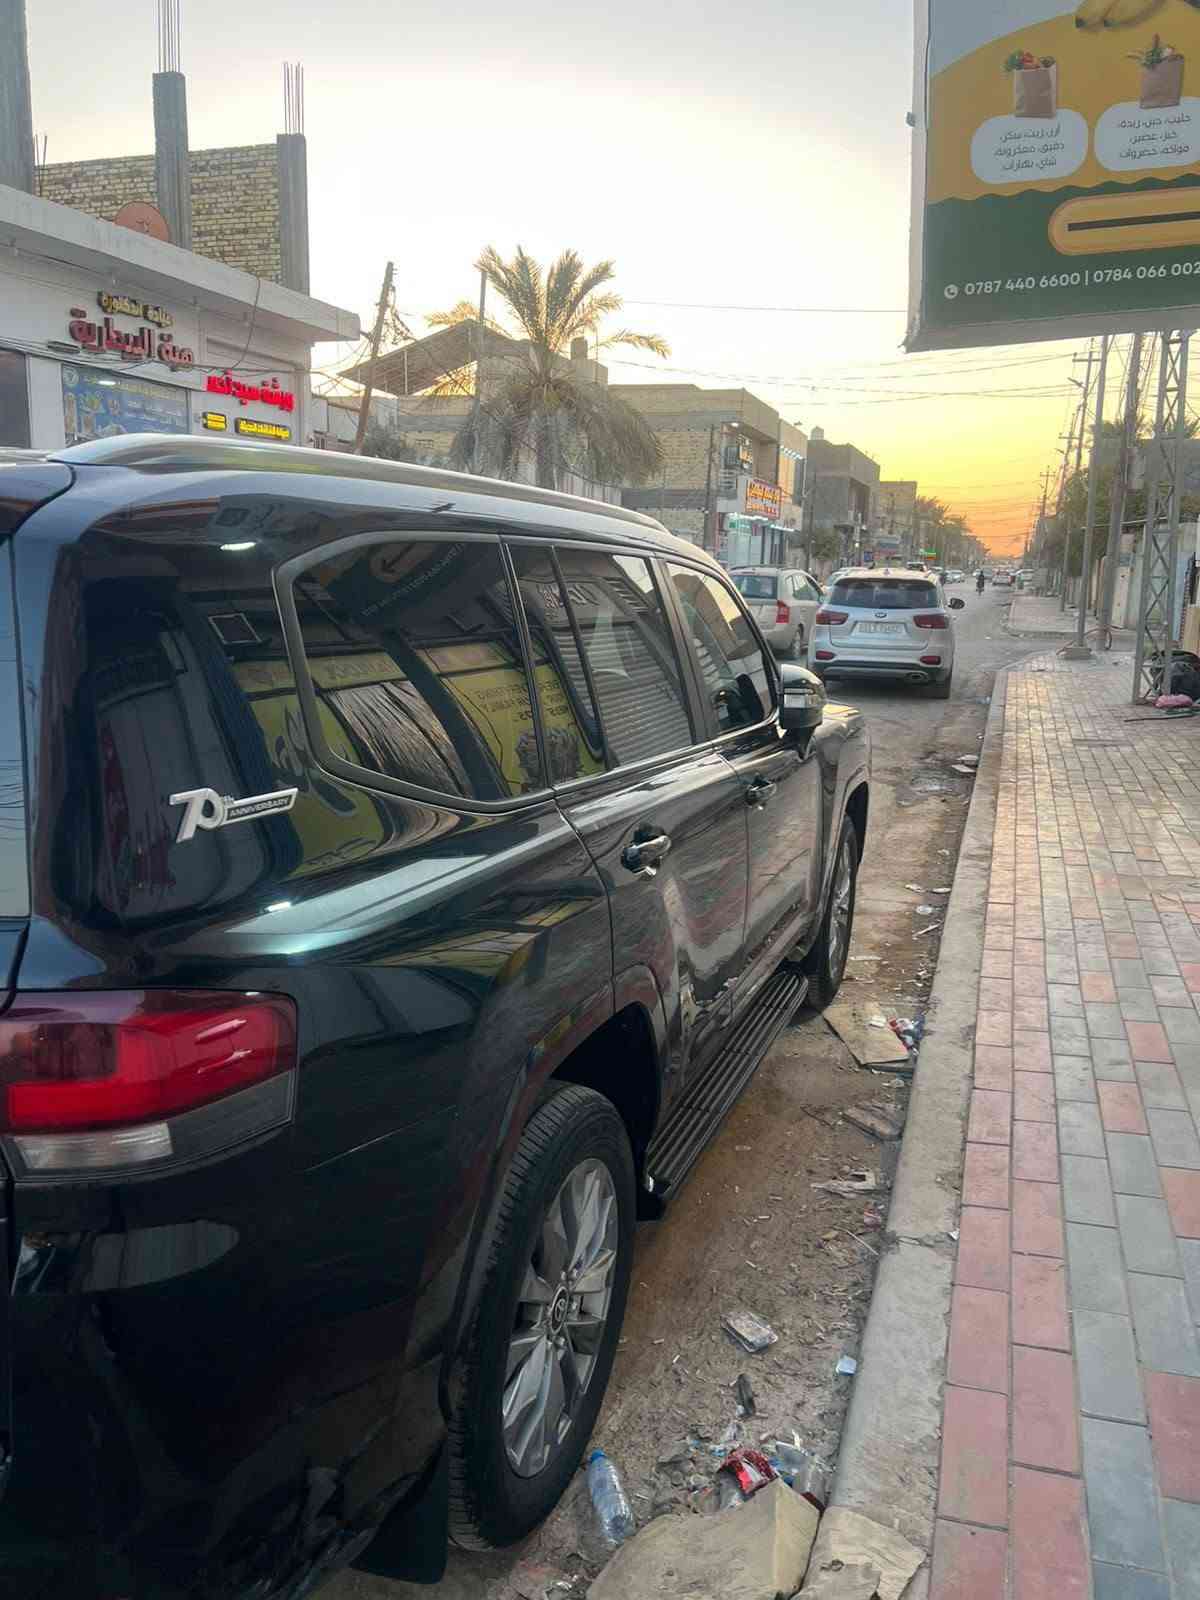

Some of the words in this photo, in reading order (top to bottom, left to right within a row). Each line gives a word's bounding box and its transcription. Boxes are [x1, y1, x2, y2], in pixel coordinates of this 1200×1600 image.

[964, 280, 1001, 296] 0787
[1005, 276, 1036, 291] 440
[1039, 271, 1081, 288] 6600
[1093, 267, 1132, 284] 0784
[1136, 263, 1167, 280] 066
[230, 798, 289, 817] ANNIVERSARY
